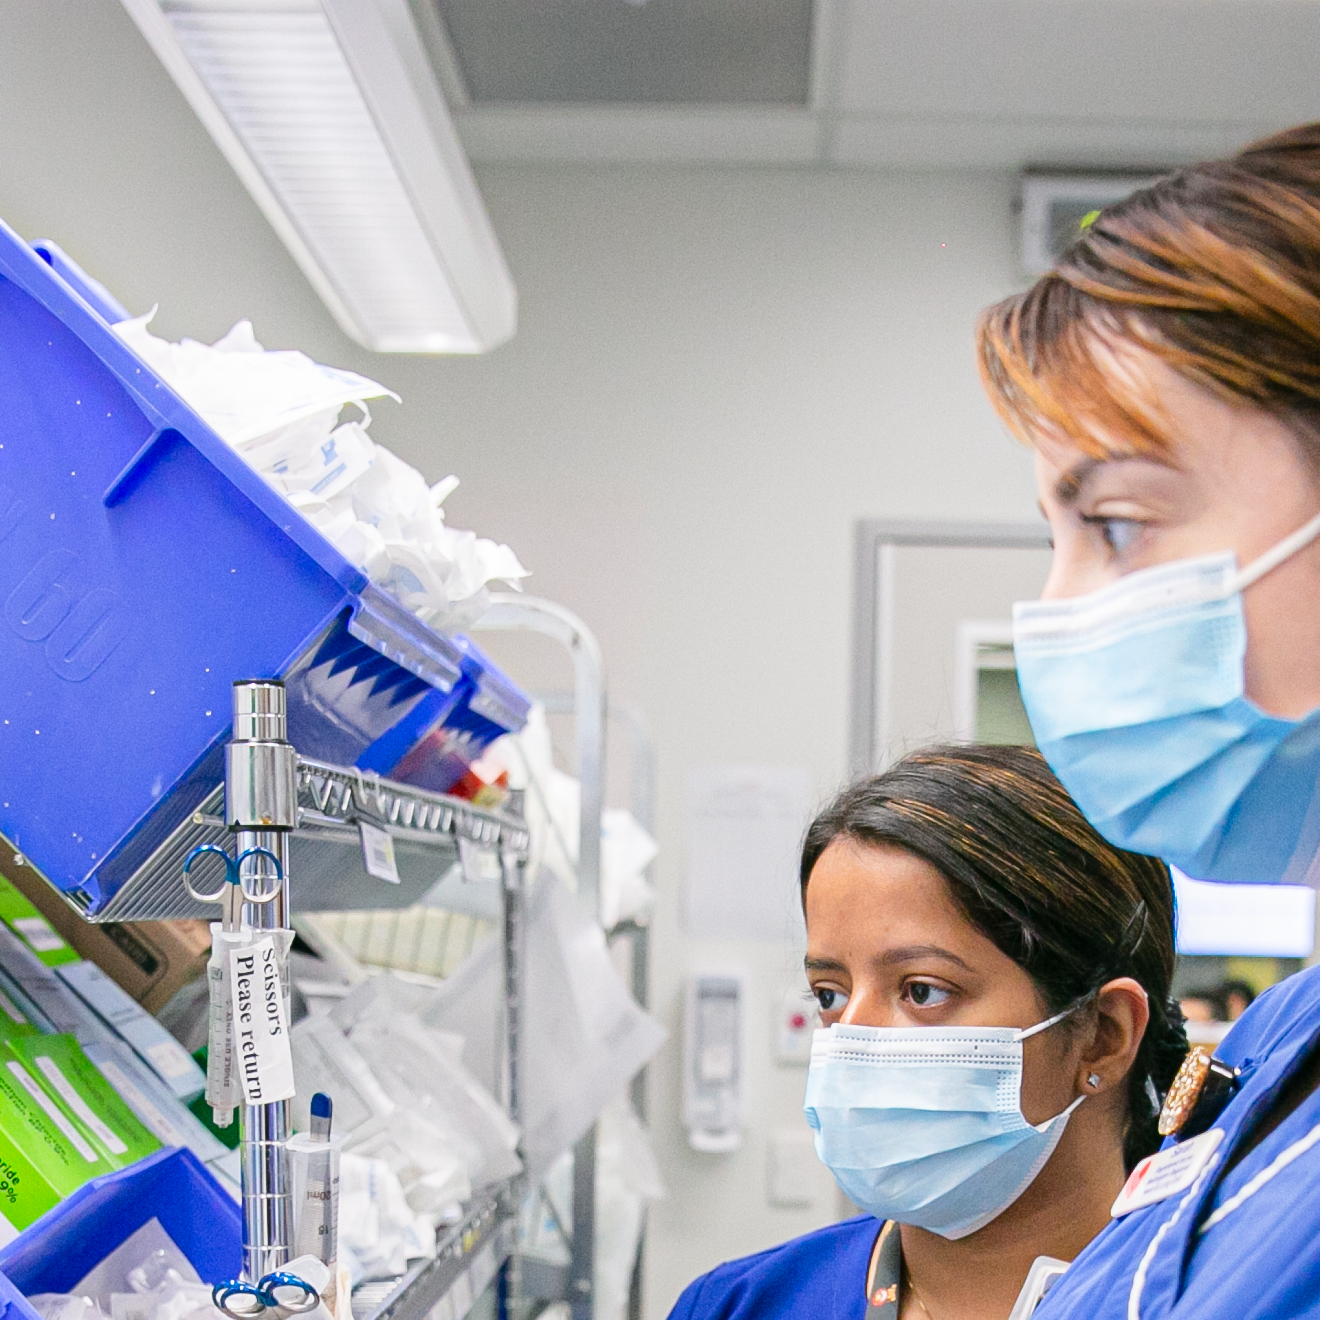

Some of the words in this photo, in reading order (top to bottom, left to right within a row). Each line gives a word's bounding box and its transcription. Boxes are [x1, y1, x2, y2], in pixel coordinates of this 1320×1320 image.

[6, 549, 126, 683] 60
[236, 954, 255, 1023] Please
[262, 947, 283, 1036] Scissors
[223, 1057, 231, 1088] SINGLE
[241, 1030, 263, 1100] return
[306, 1190, 331, 1201] 20ml
